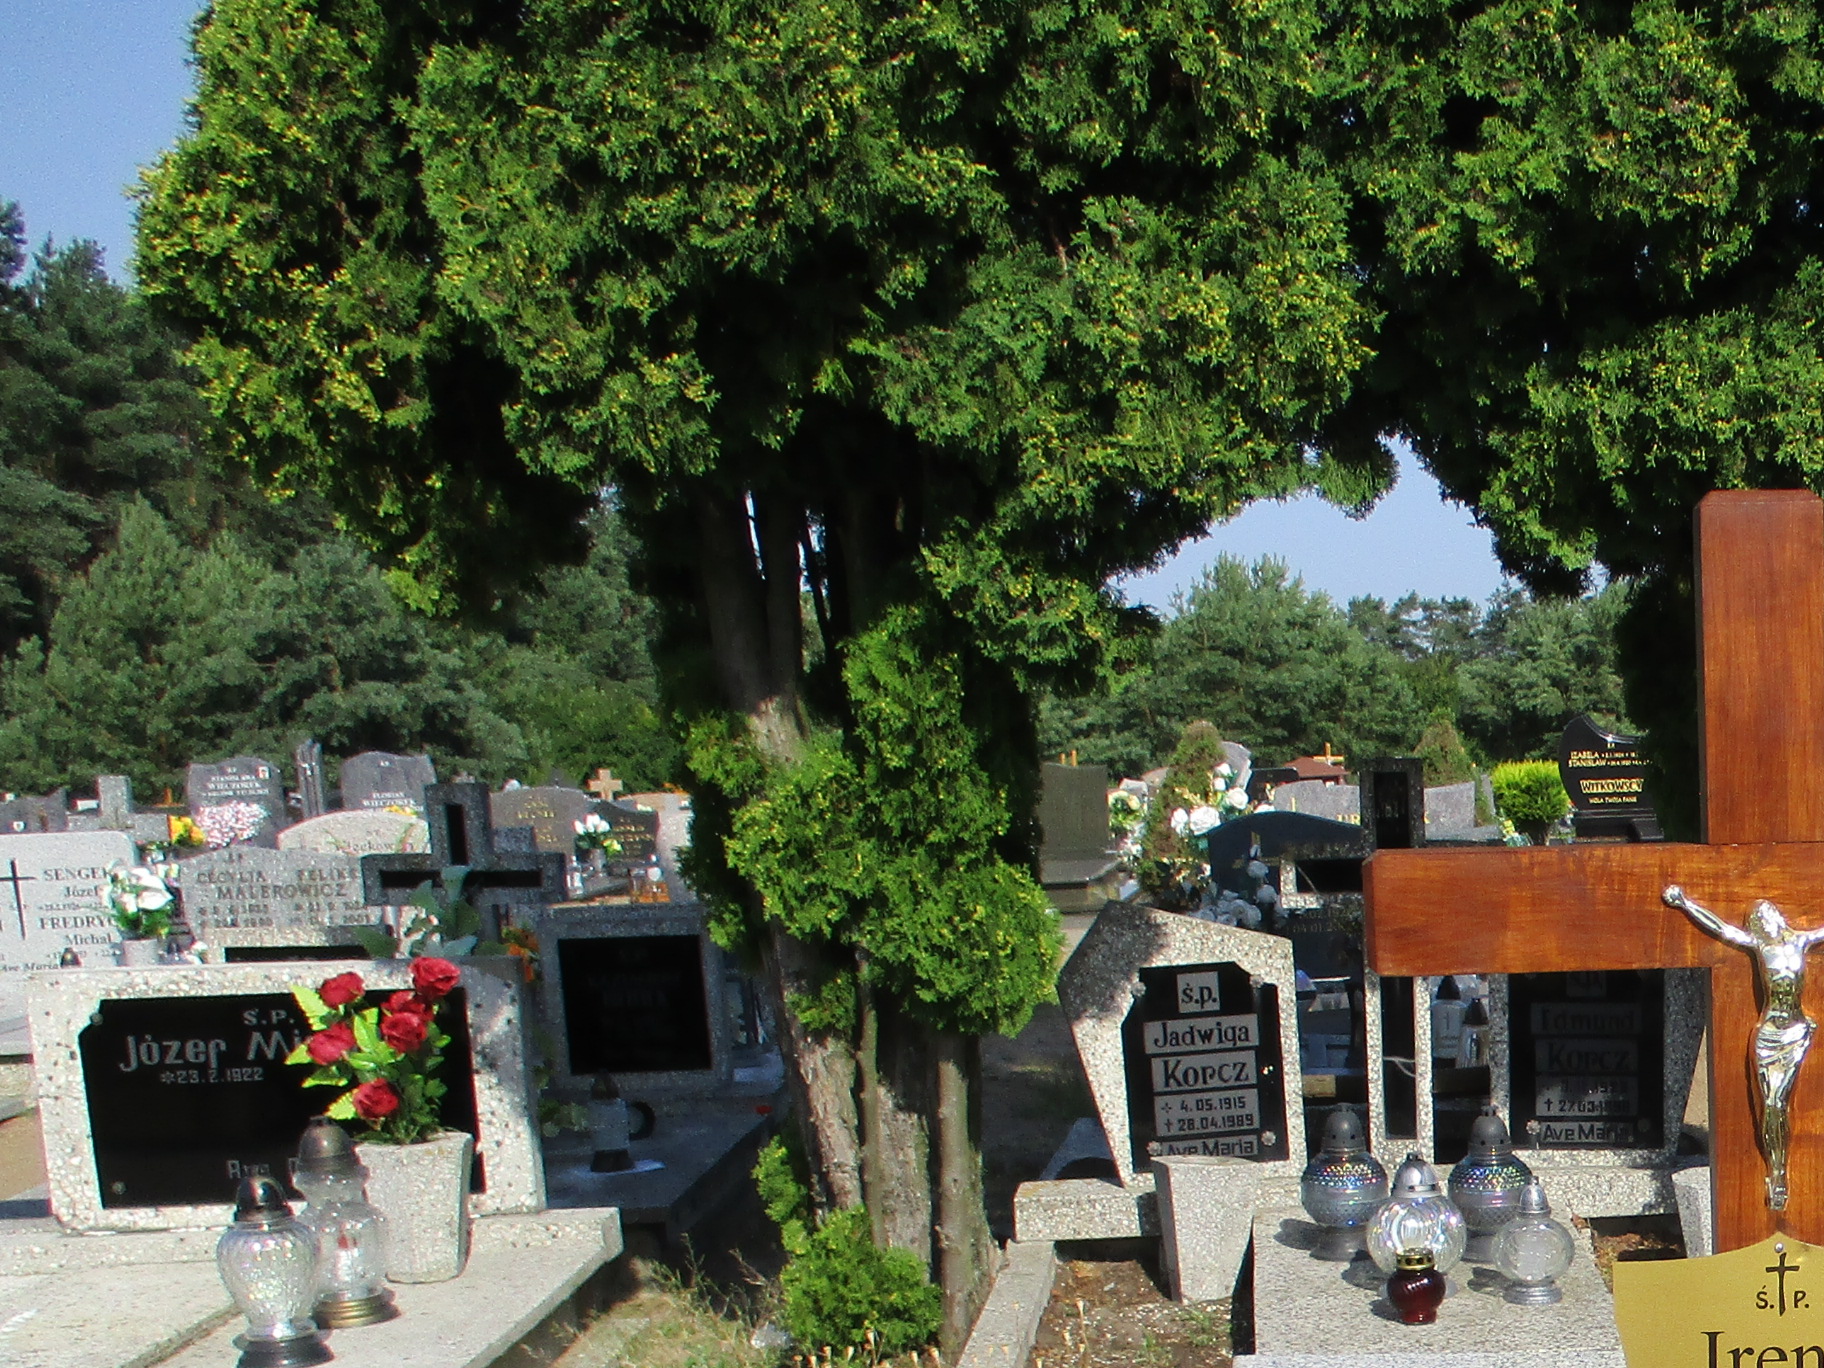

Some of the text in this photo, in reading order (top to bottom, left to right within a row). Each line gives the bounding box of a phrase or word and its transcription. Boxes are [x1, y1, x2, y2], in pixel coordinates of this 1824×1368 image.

[1580, 779, 1644, 793] WITKOWSCY
[1181, 983, 1217, 1009] ś.p.
[242, 1007, 295, 1026] Ś.P.
[1154, 1021, 1250, 1048] Jadwiga
[1177, 1114, 1254, 1132] 28.04.1989
[1543, 1124, 1574, 1141] Ave
[1166, 1139, 1255, 1156] Ave Maria
